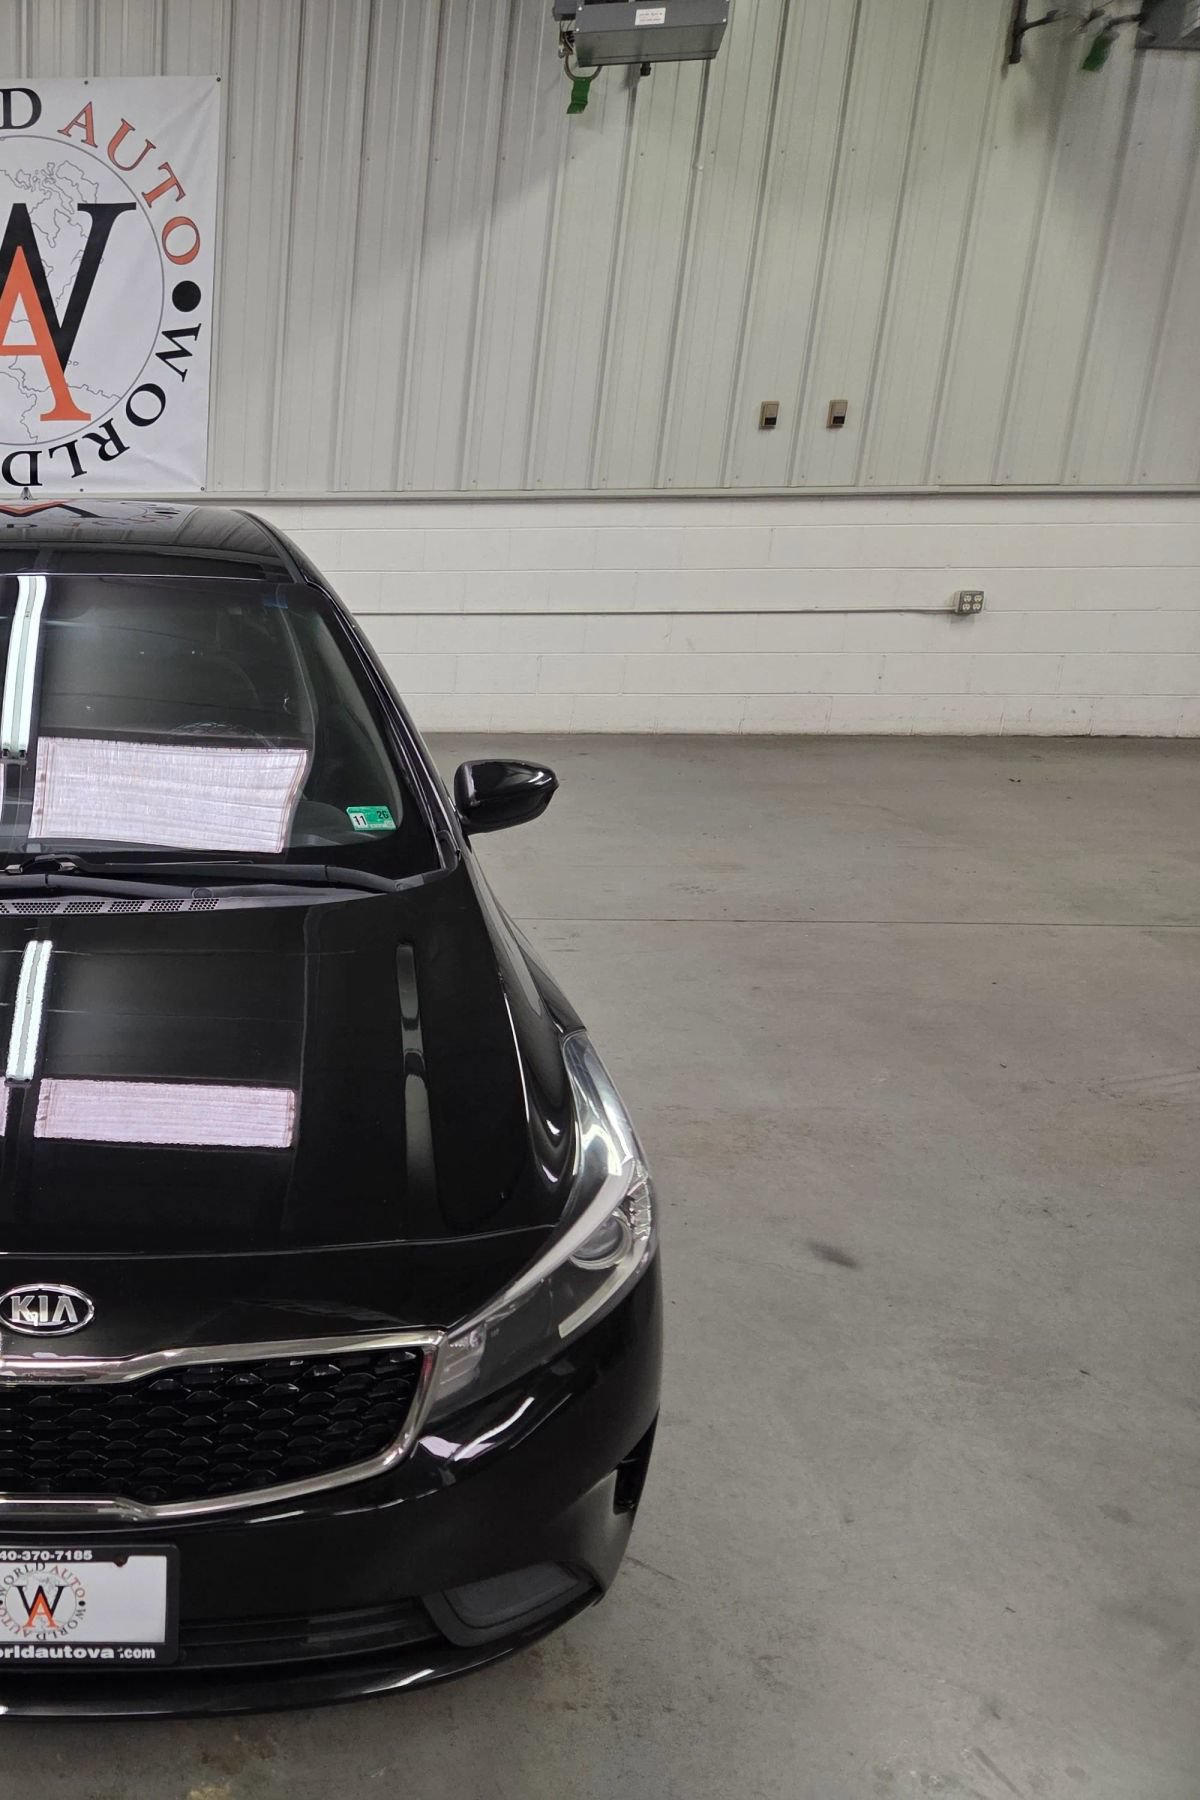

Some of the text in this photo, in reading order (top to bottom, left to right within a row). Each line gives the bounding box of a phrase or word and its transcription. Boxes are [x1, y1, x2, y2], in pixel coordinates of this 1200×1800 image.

[57, 101, 201, 265] AUTO
[1, 323, 202, 487] WORLD
[10, 1295, 79, 1323] KIA
[50, 1565, 86, 1598] AUTO
[36, 1608, 86, 1640] WORLD
